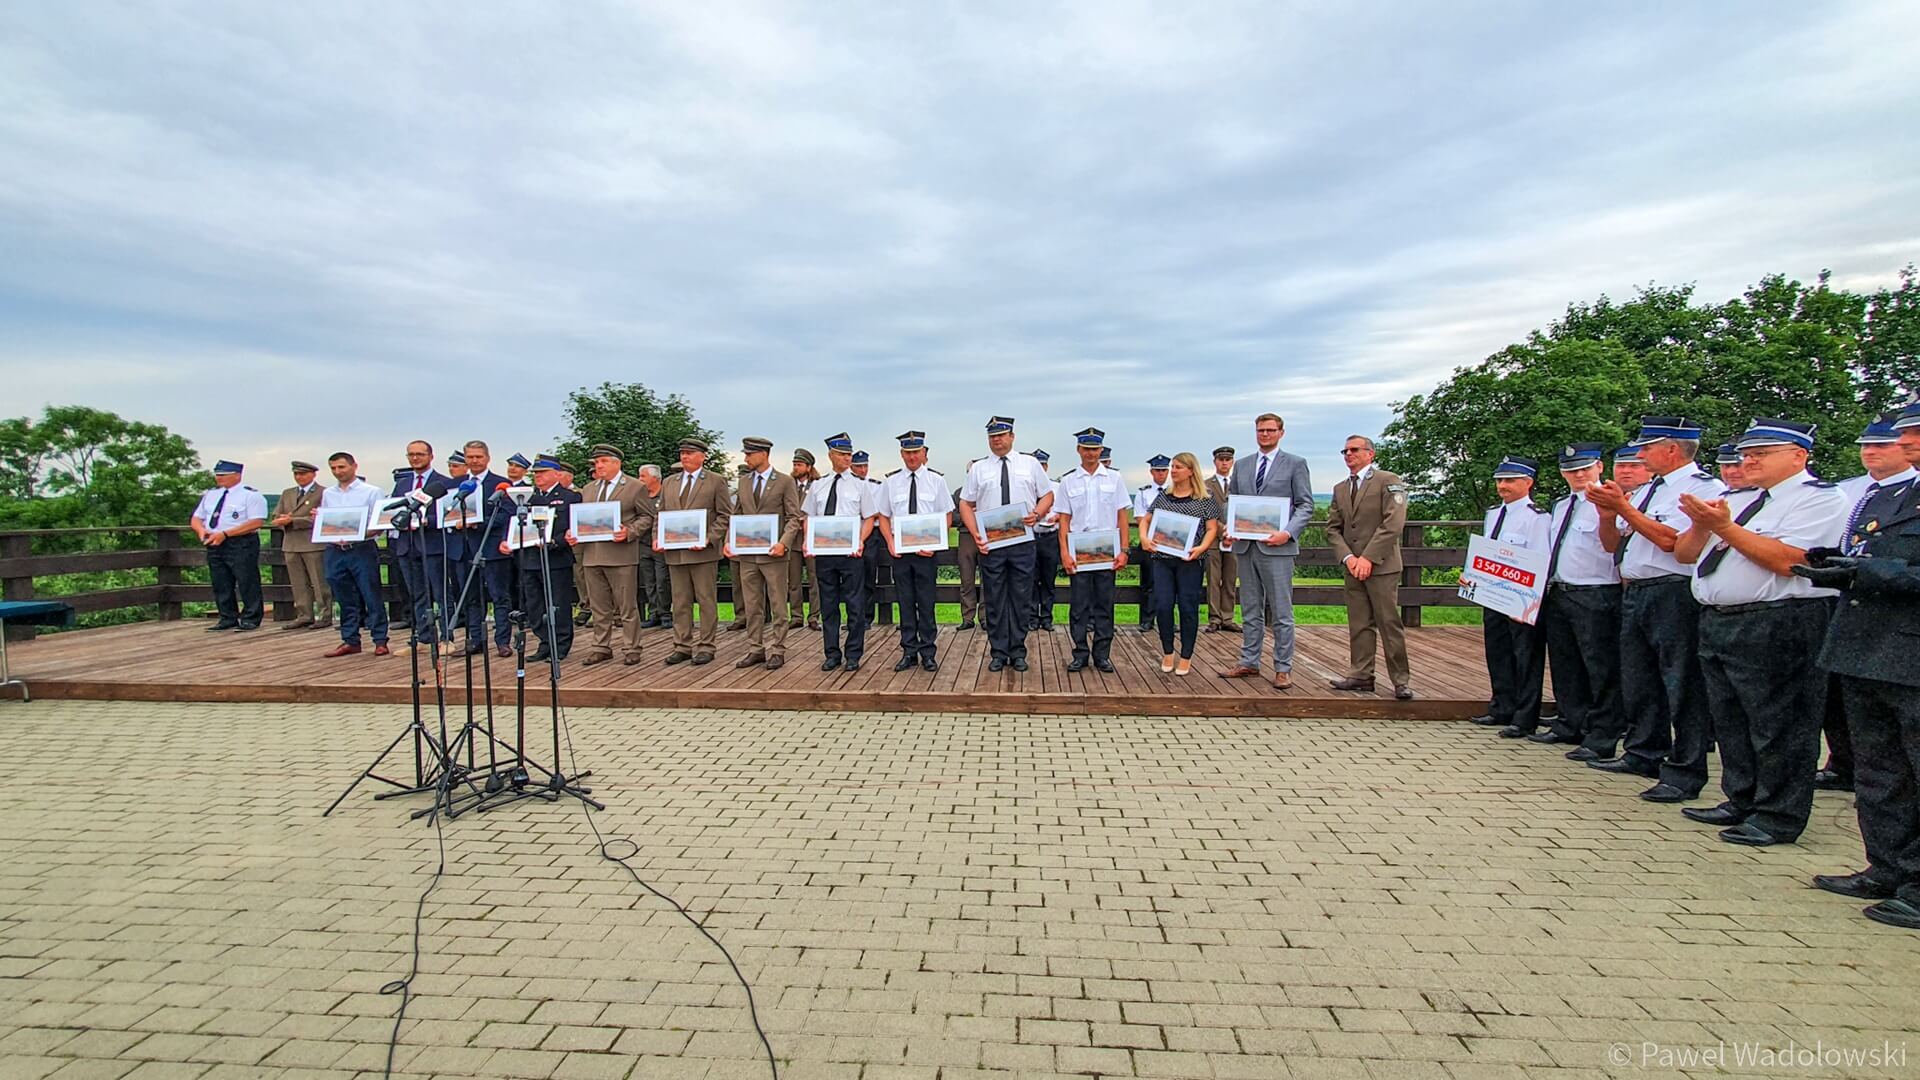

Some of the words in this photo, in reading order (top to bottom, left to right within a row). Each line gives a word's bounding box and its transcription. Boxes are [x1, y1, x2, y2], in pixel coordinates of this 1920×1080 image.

[1475, 559, 1483, 569] 3
[1484, 561, 1502, 575] 547
[1502, 567, 1521, 581] 660
[1521, 575, 1530, 585] zł
